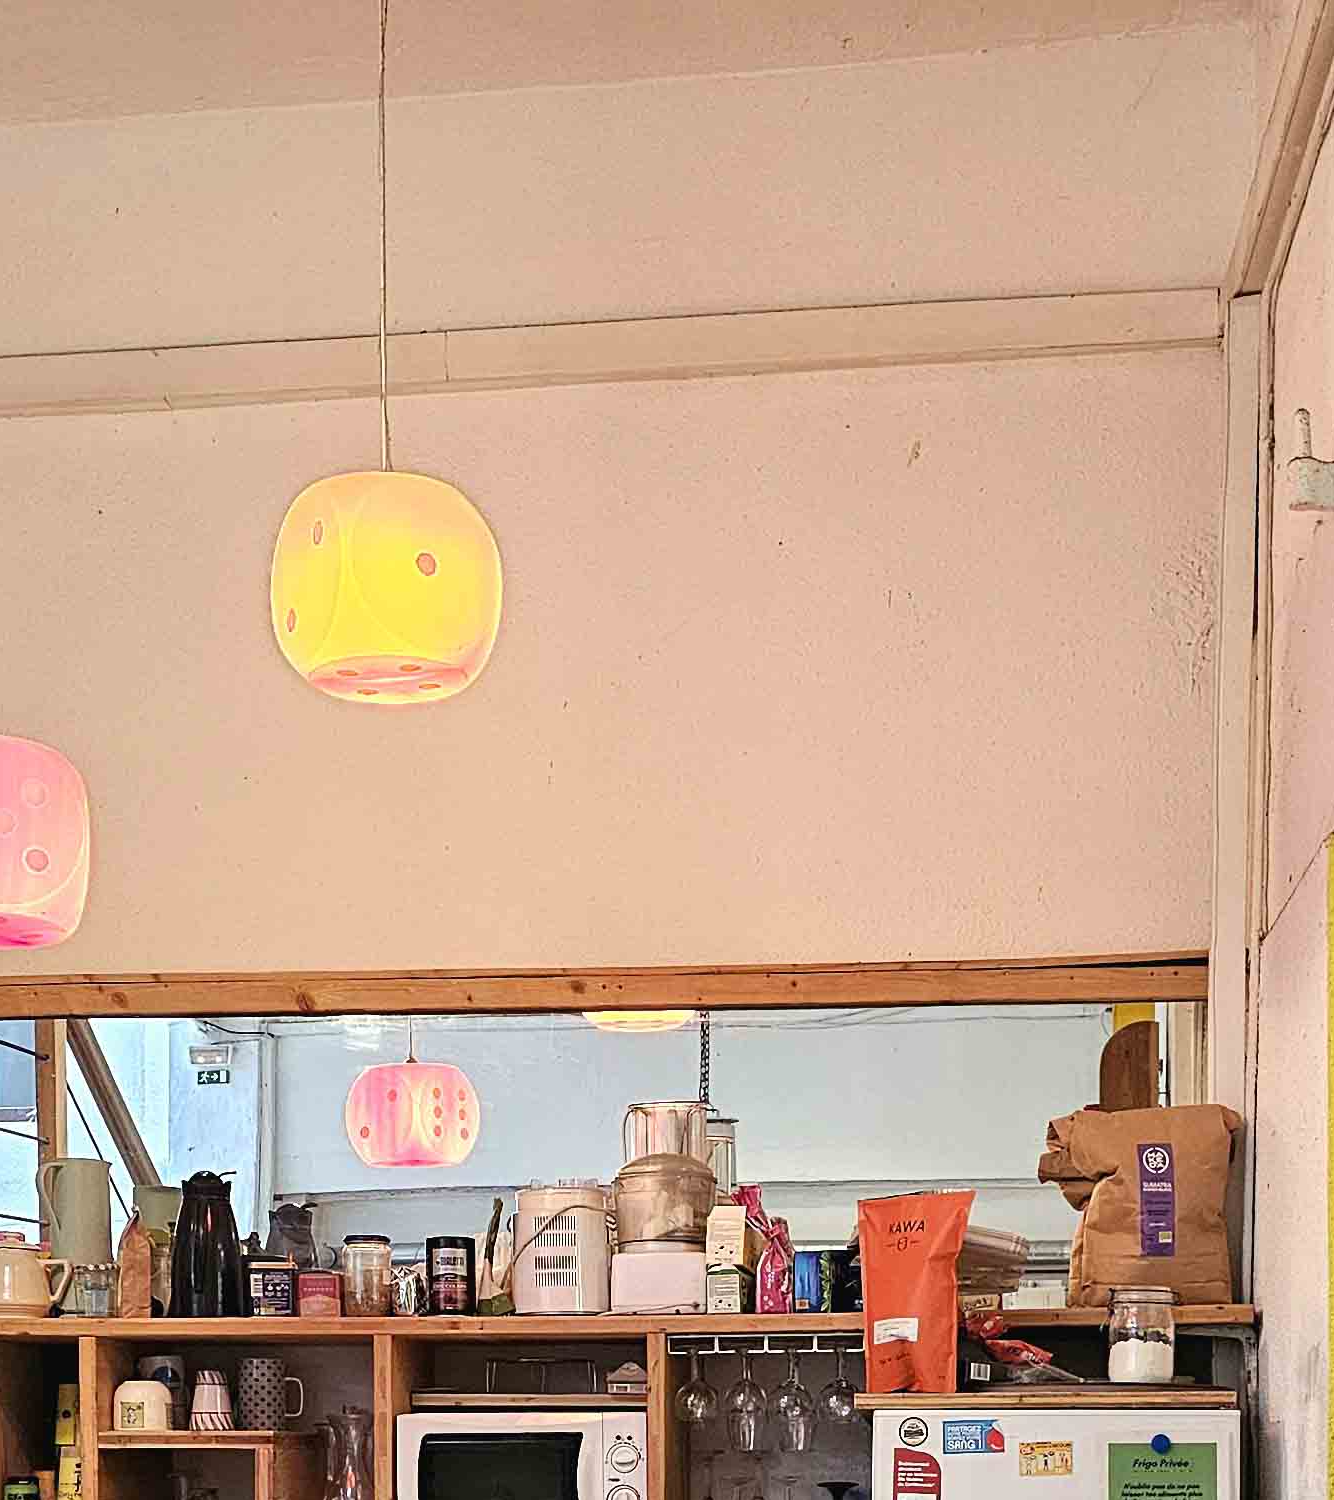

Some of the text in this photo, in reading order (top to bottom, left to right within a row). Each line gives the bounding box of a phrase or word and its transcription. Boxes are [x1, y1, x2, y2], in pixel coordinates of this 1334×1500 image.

[889, 1220, 925, 1233] KAWA
[947, 1440, 976, 1450] SANG
[1132, 1459, 1157, 1469] Frigo
